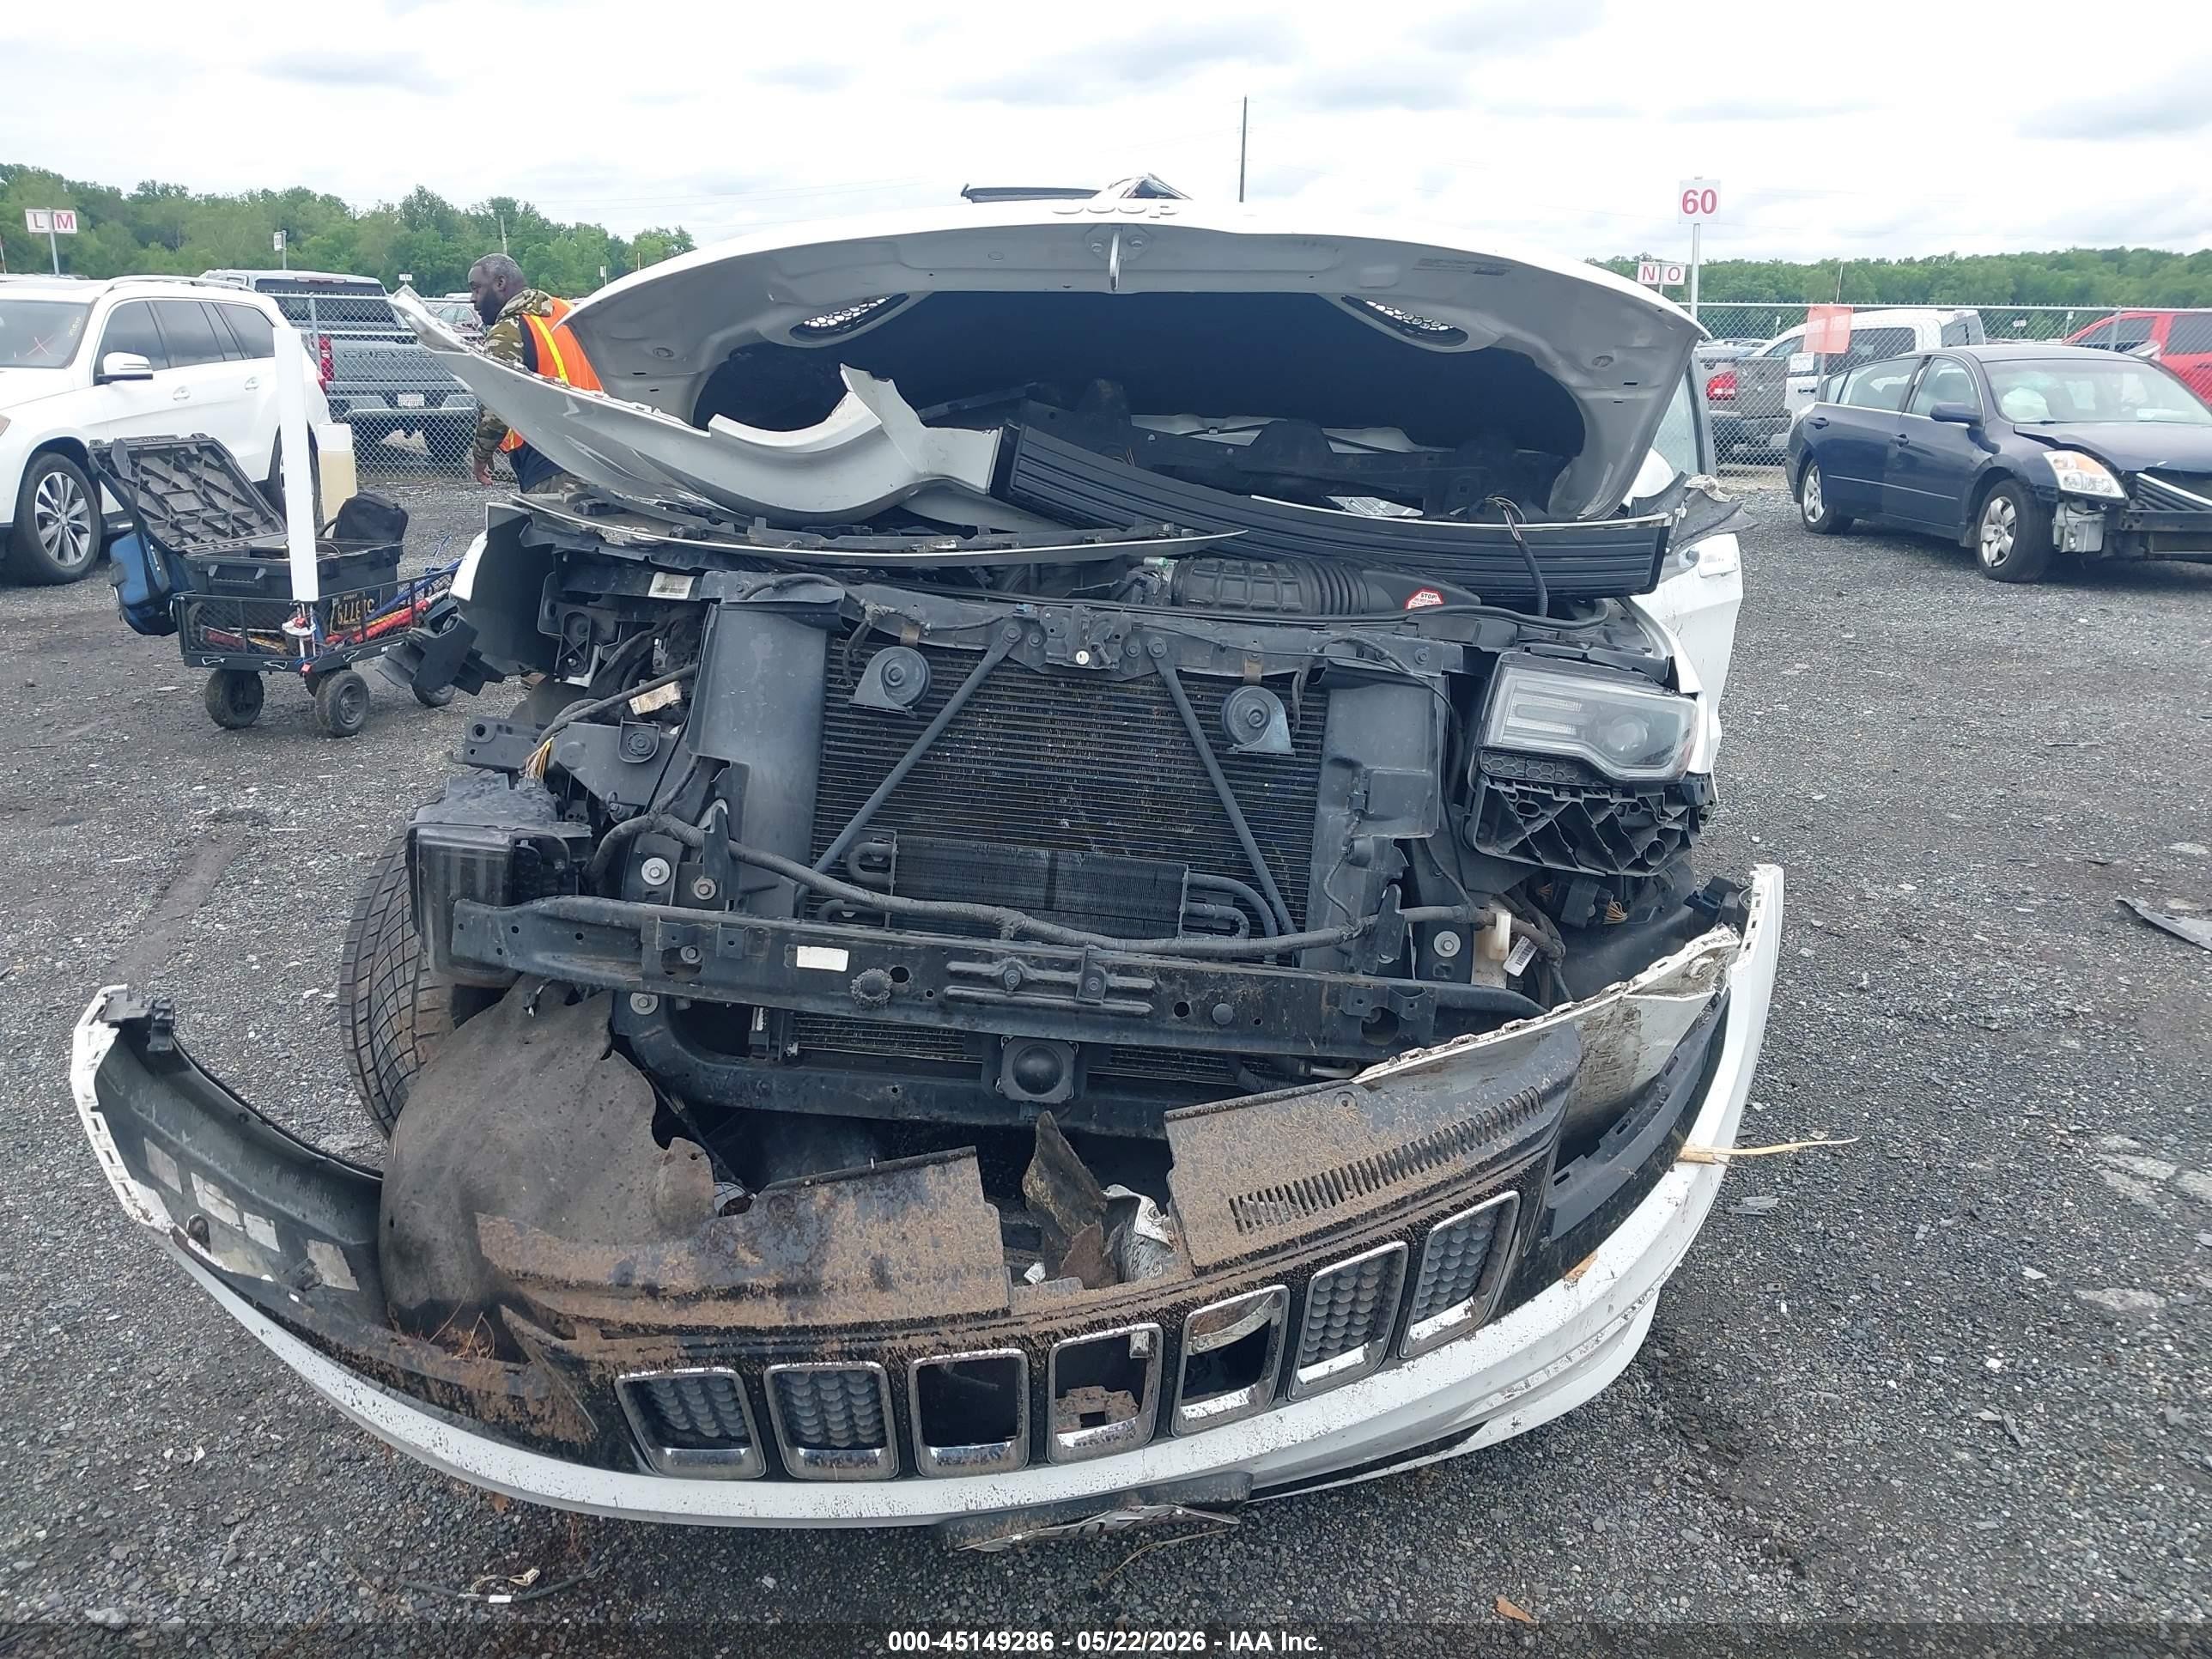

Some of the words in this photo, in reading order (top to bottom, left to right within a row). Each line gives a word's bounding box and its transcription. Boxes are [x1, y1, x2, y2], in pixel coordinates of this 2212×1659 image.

[1682, 189, 1717, 215] 60
[33, 213, 44, 228] L
[56, 214, 74, 229] M
[1642, 265, 1656, 281] N
[1668, 266, 1681, 282] O
